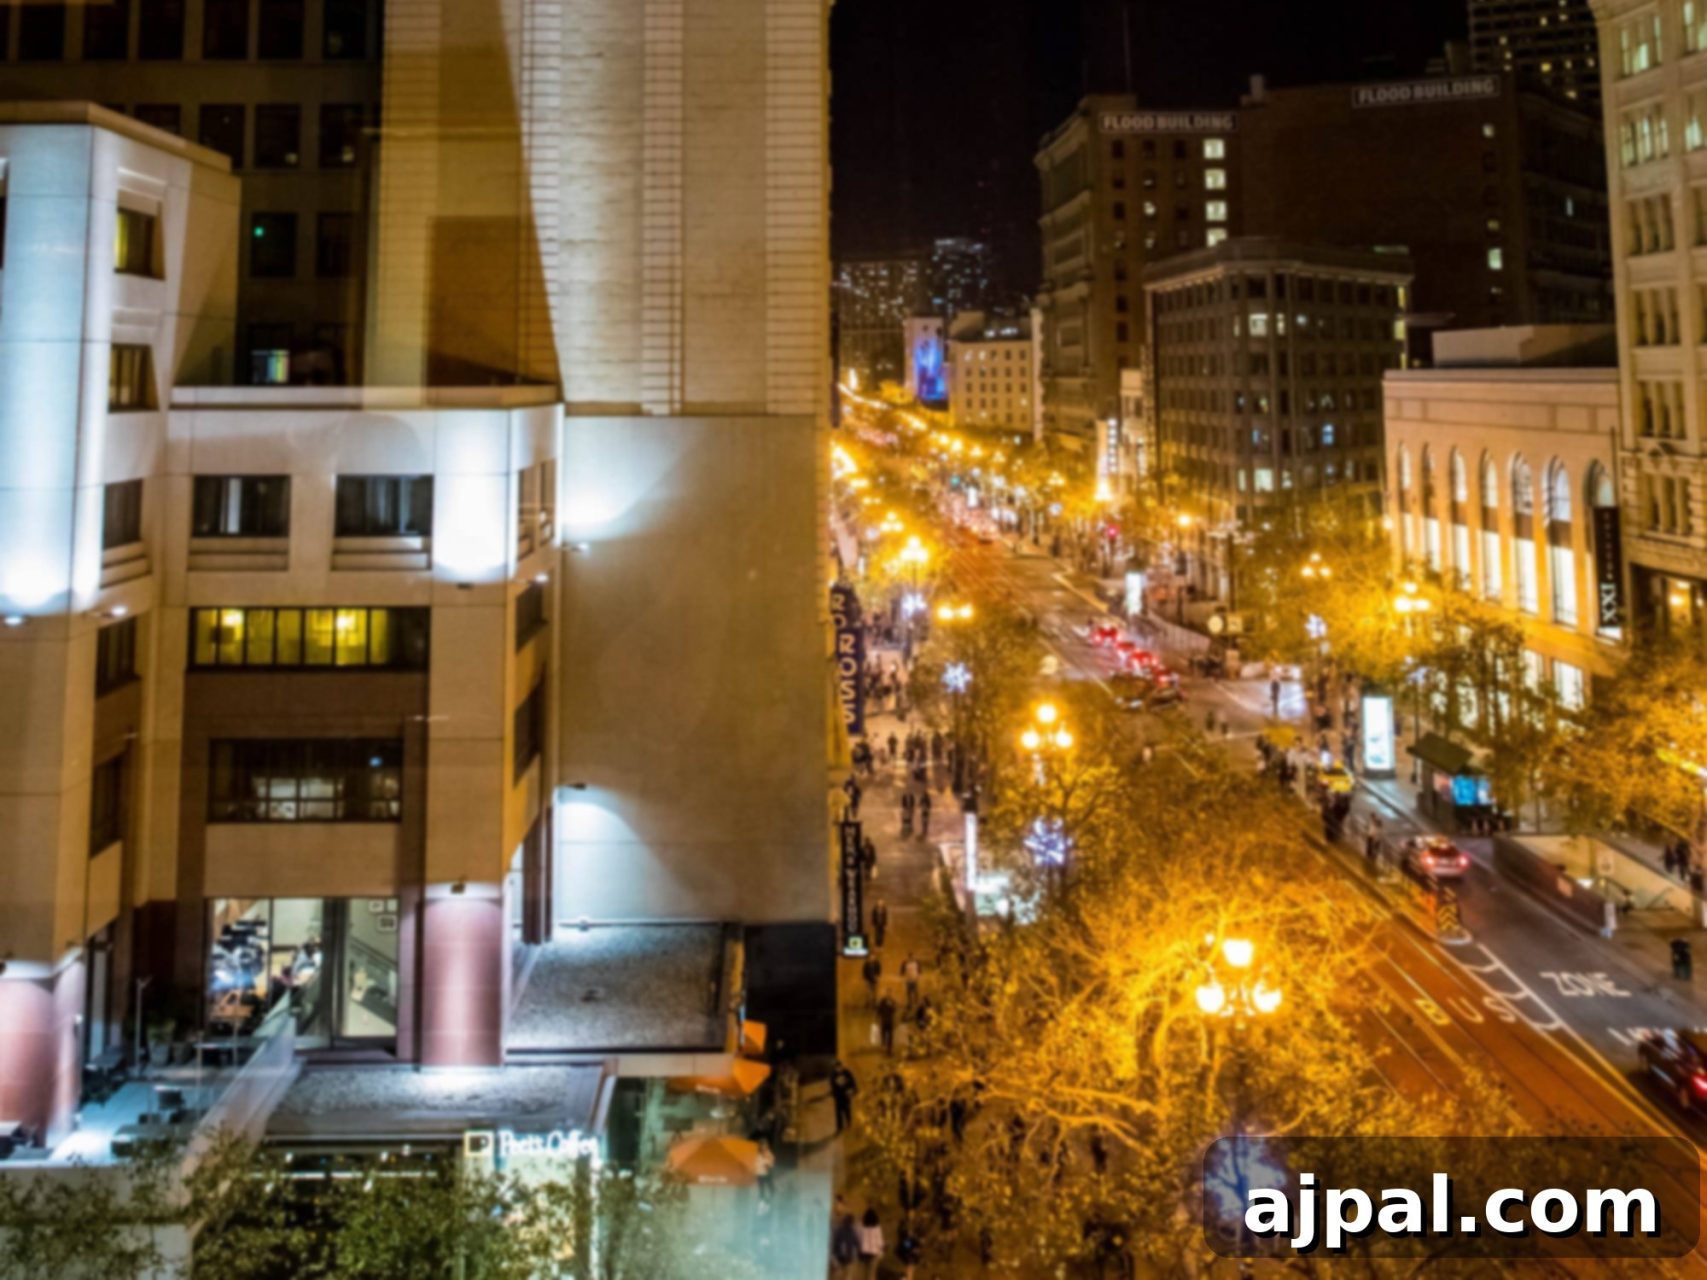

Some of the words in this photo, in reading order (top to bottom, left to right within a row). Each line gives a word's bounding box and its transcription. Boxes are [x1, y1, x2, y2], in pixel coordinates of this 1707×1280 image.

[1358, 85, 1411, 104] FLOOD
[1413, 78, 1495, 100] BUILDING
[1103, 115, 1154, 130] FLOOD
[1156, 115, 1234, 130] BUILDING
[839, 632, 858, 724] ROSS
[1539, 971, 1632, 998] ZONE
[1414, 996, 1517, 1026] BUS
